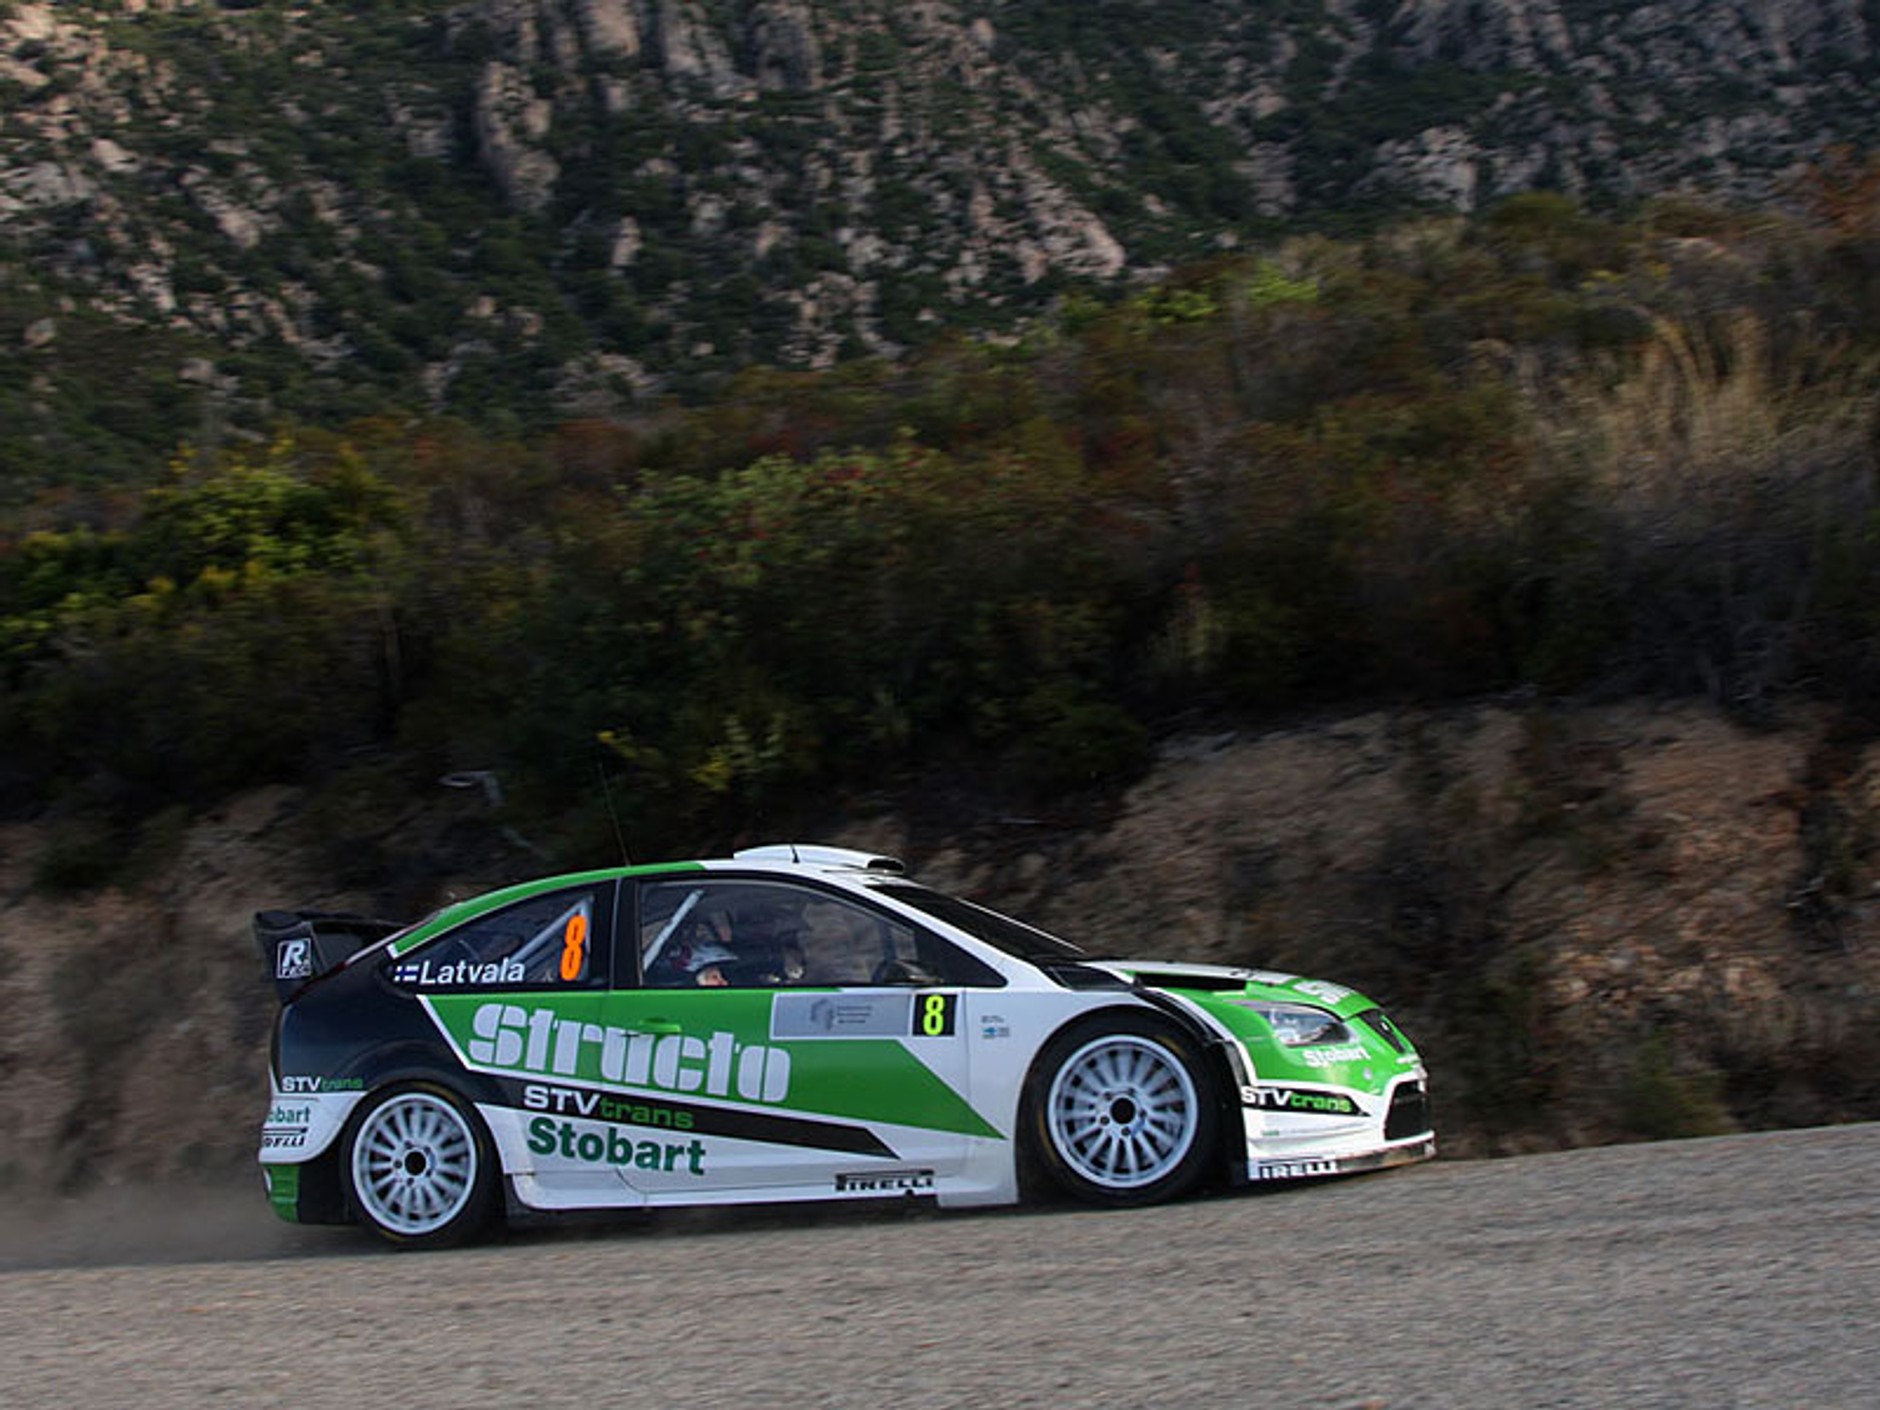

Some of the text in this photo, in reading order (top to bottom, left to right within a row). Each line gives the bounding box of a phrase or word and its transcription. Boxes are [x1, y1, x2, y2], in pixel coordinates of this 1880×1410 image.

[560, 915, 587, 981] 8
[420, 957, 526, 985] Latvala
[923, 994, 945, 1036] 8
[523, 1085, 695, 1129] STVtrans
[1240, 1086, 1352, 1113] STVtrans
[527, 1117, 706, 1176] Stobart
